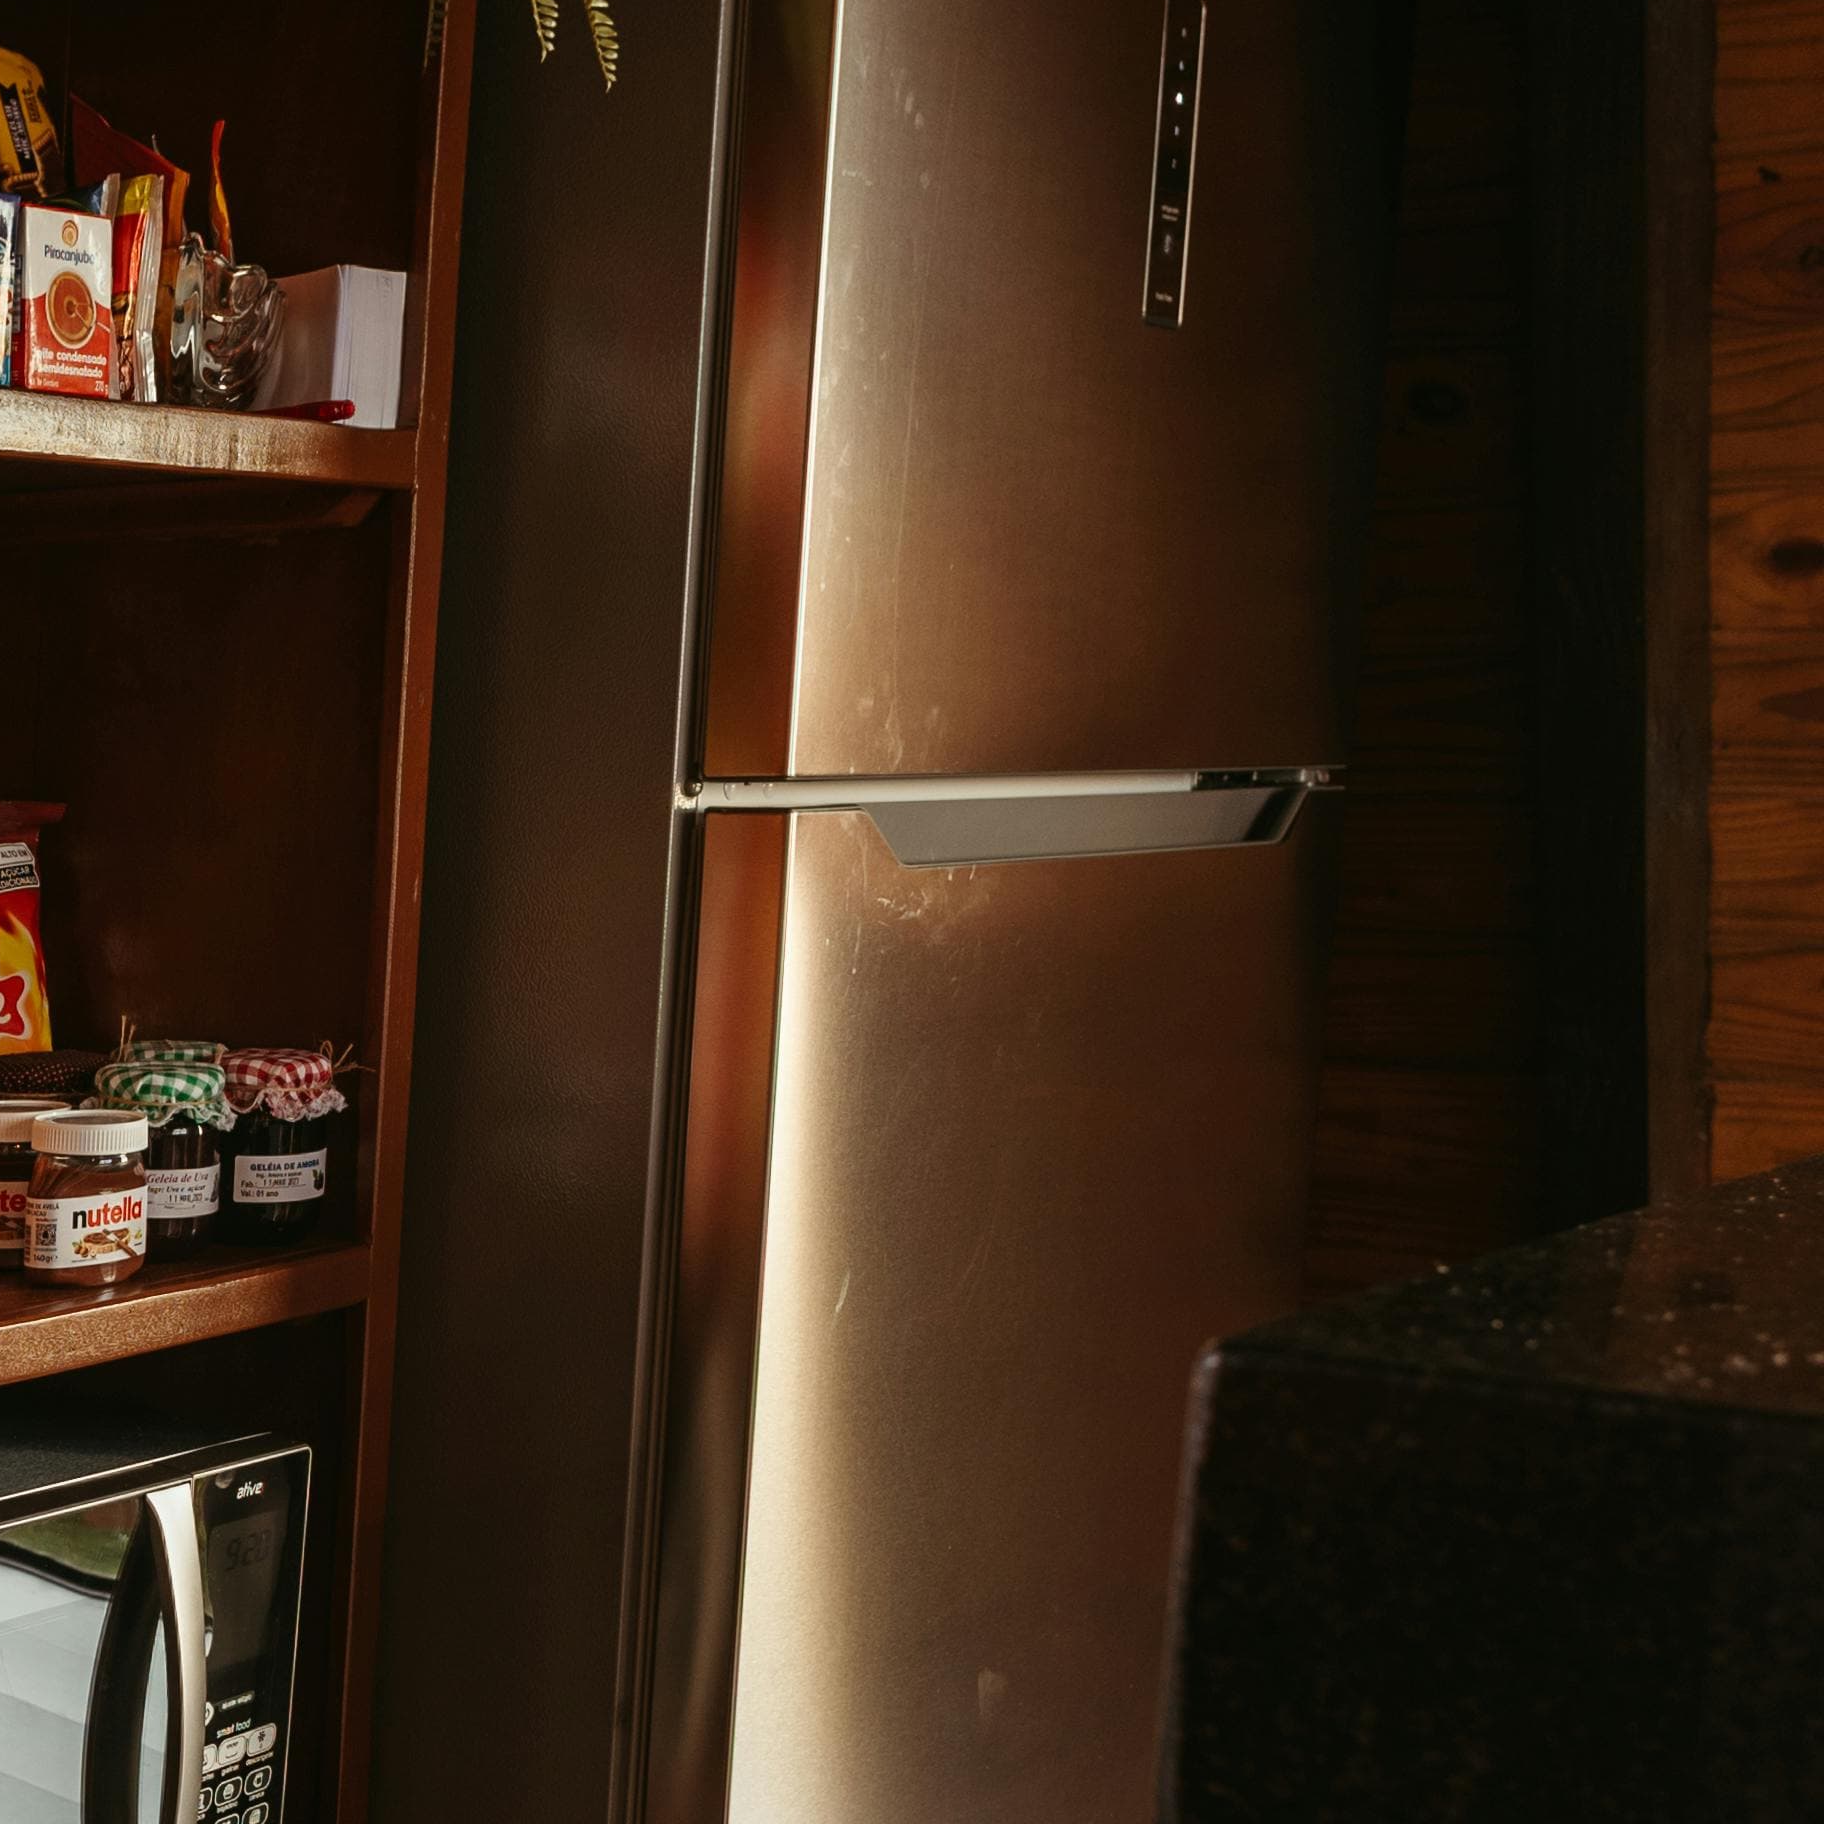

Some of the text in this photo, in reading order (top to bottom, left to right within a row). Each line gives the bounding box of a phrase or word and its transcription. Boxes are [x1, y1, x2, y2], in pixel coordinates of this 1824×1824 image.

[56, 350, 107, 367] condensado
[0, 850, 17, 860] ALTO
[0, 866, 31, 880] AÇÚCAR
[250, 1159, 320, 1171] GELÉIA DE AMORA
[147, 1173, 178, 1184] Geleia
[180, 1174, 192, 1183] de
[72, 1196, 142, 1230] nutella
